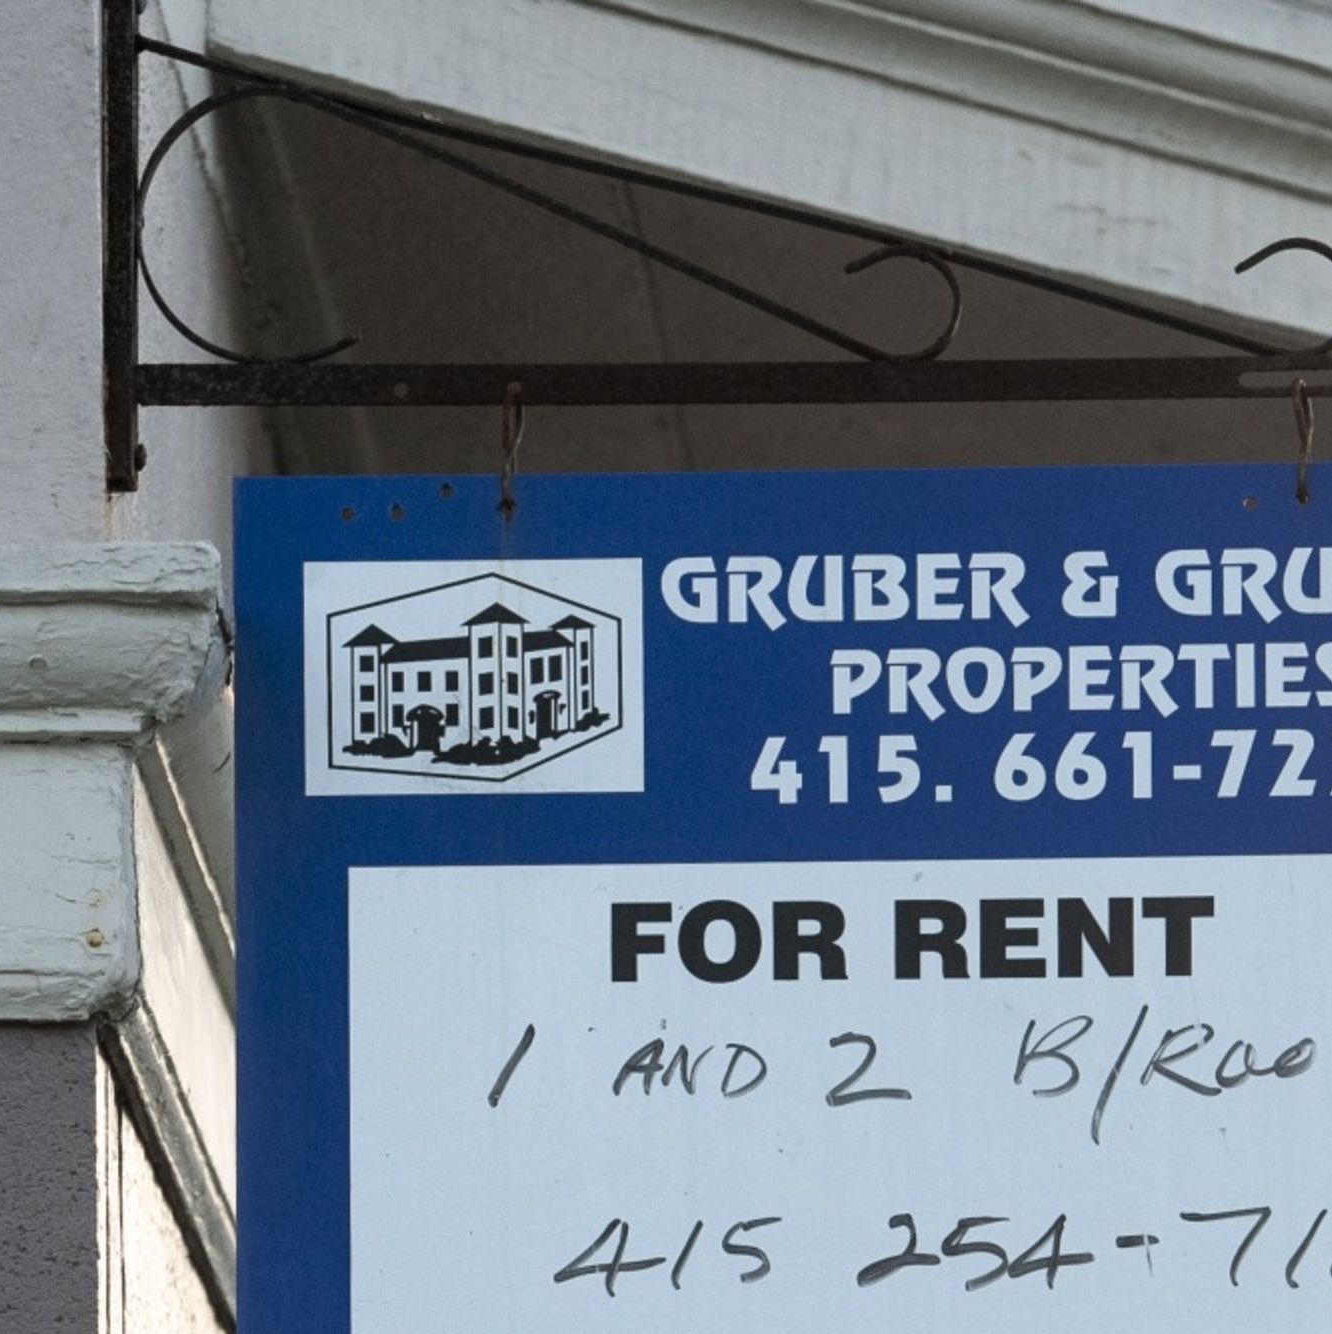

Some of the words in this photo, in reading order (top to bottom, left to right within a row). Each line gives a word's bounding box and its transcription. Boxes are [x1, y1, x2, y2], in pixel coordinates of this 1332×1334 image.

[661, 552, 1030, 631] GRUBER
[1061, 551, 1119, 617] &
[750, 734, 952, 804] 415.
[610, 899, 849, 985] FOR
[893, 895, 1215, 981] RENT
[612, 1037, 768, 1098] AND
[825, 1031, 913, 1108] 2
[553, 1216, 783, 1298] 415
